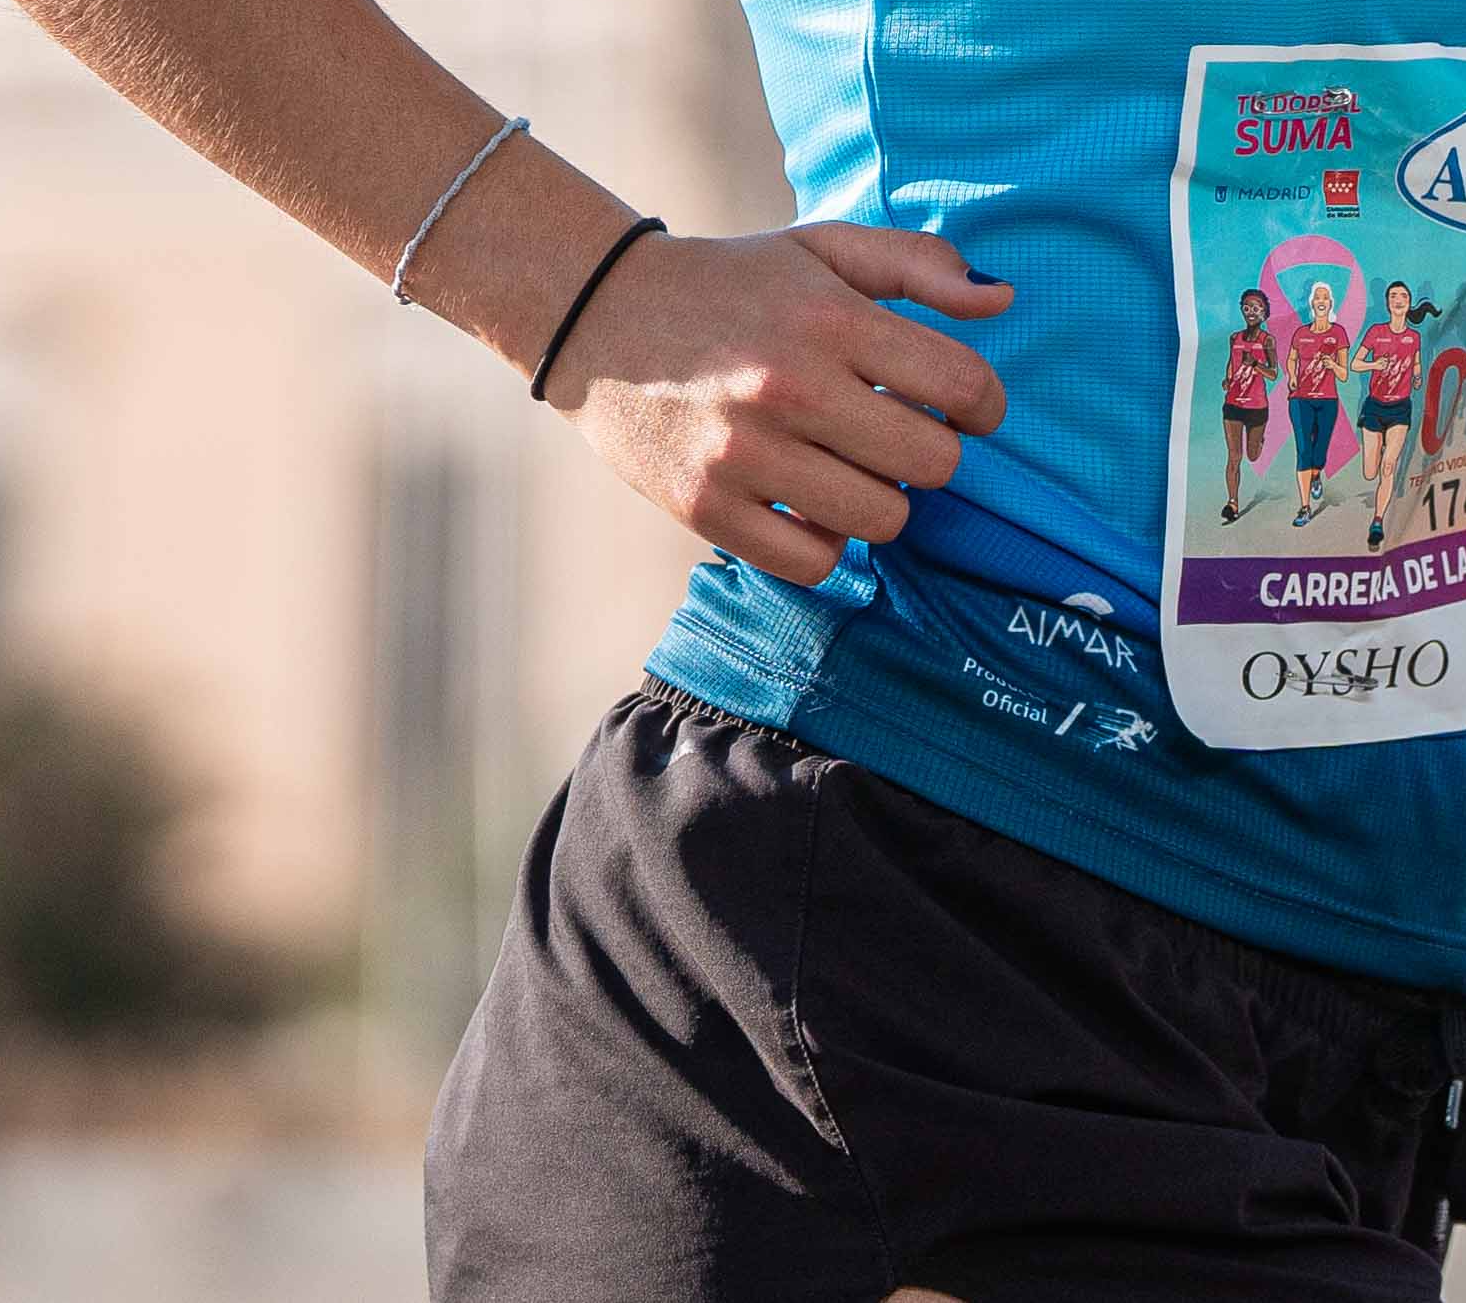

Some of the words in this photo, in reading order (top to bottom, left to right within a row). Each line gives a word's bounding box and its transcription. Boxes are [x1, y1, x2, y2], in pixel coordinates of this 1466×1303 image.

[1235, 117, 1352, 156] SUMA
[1237, 185, 1311, 201] MADRID
[1260, 565, 1400, 607] CARRERA
[1403, 555, 1438, 593] DE
[1007, 605, 1138, 673] AIMAR
[1242, 639, 1450, 701] OYSHO
[982, 689, 1048, 725] Oficial
